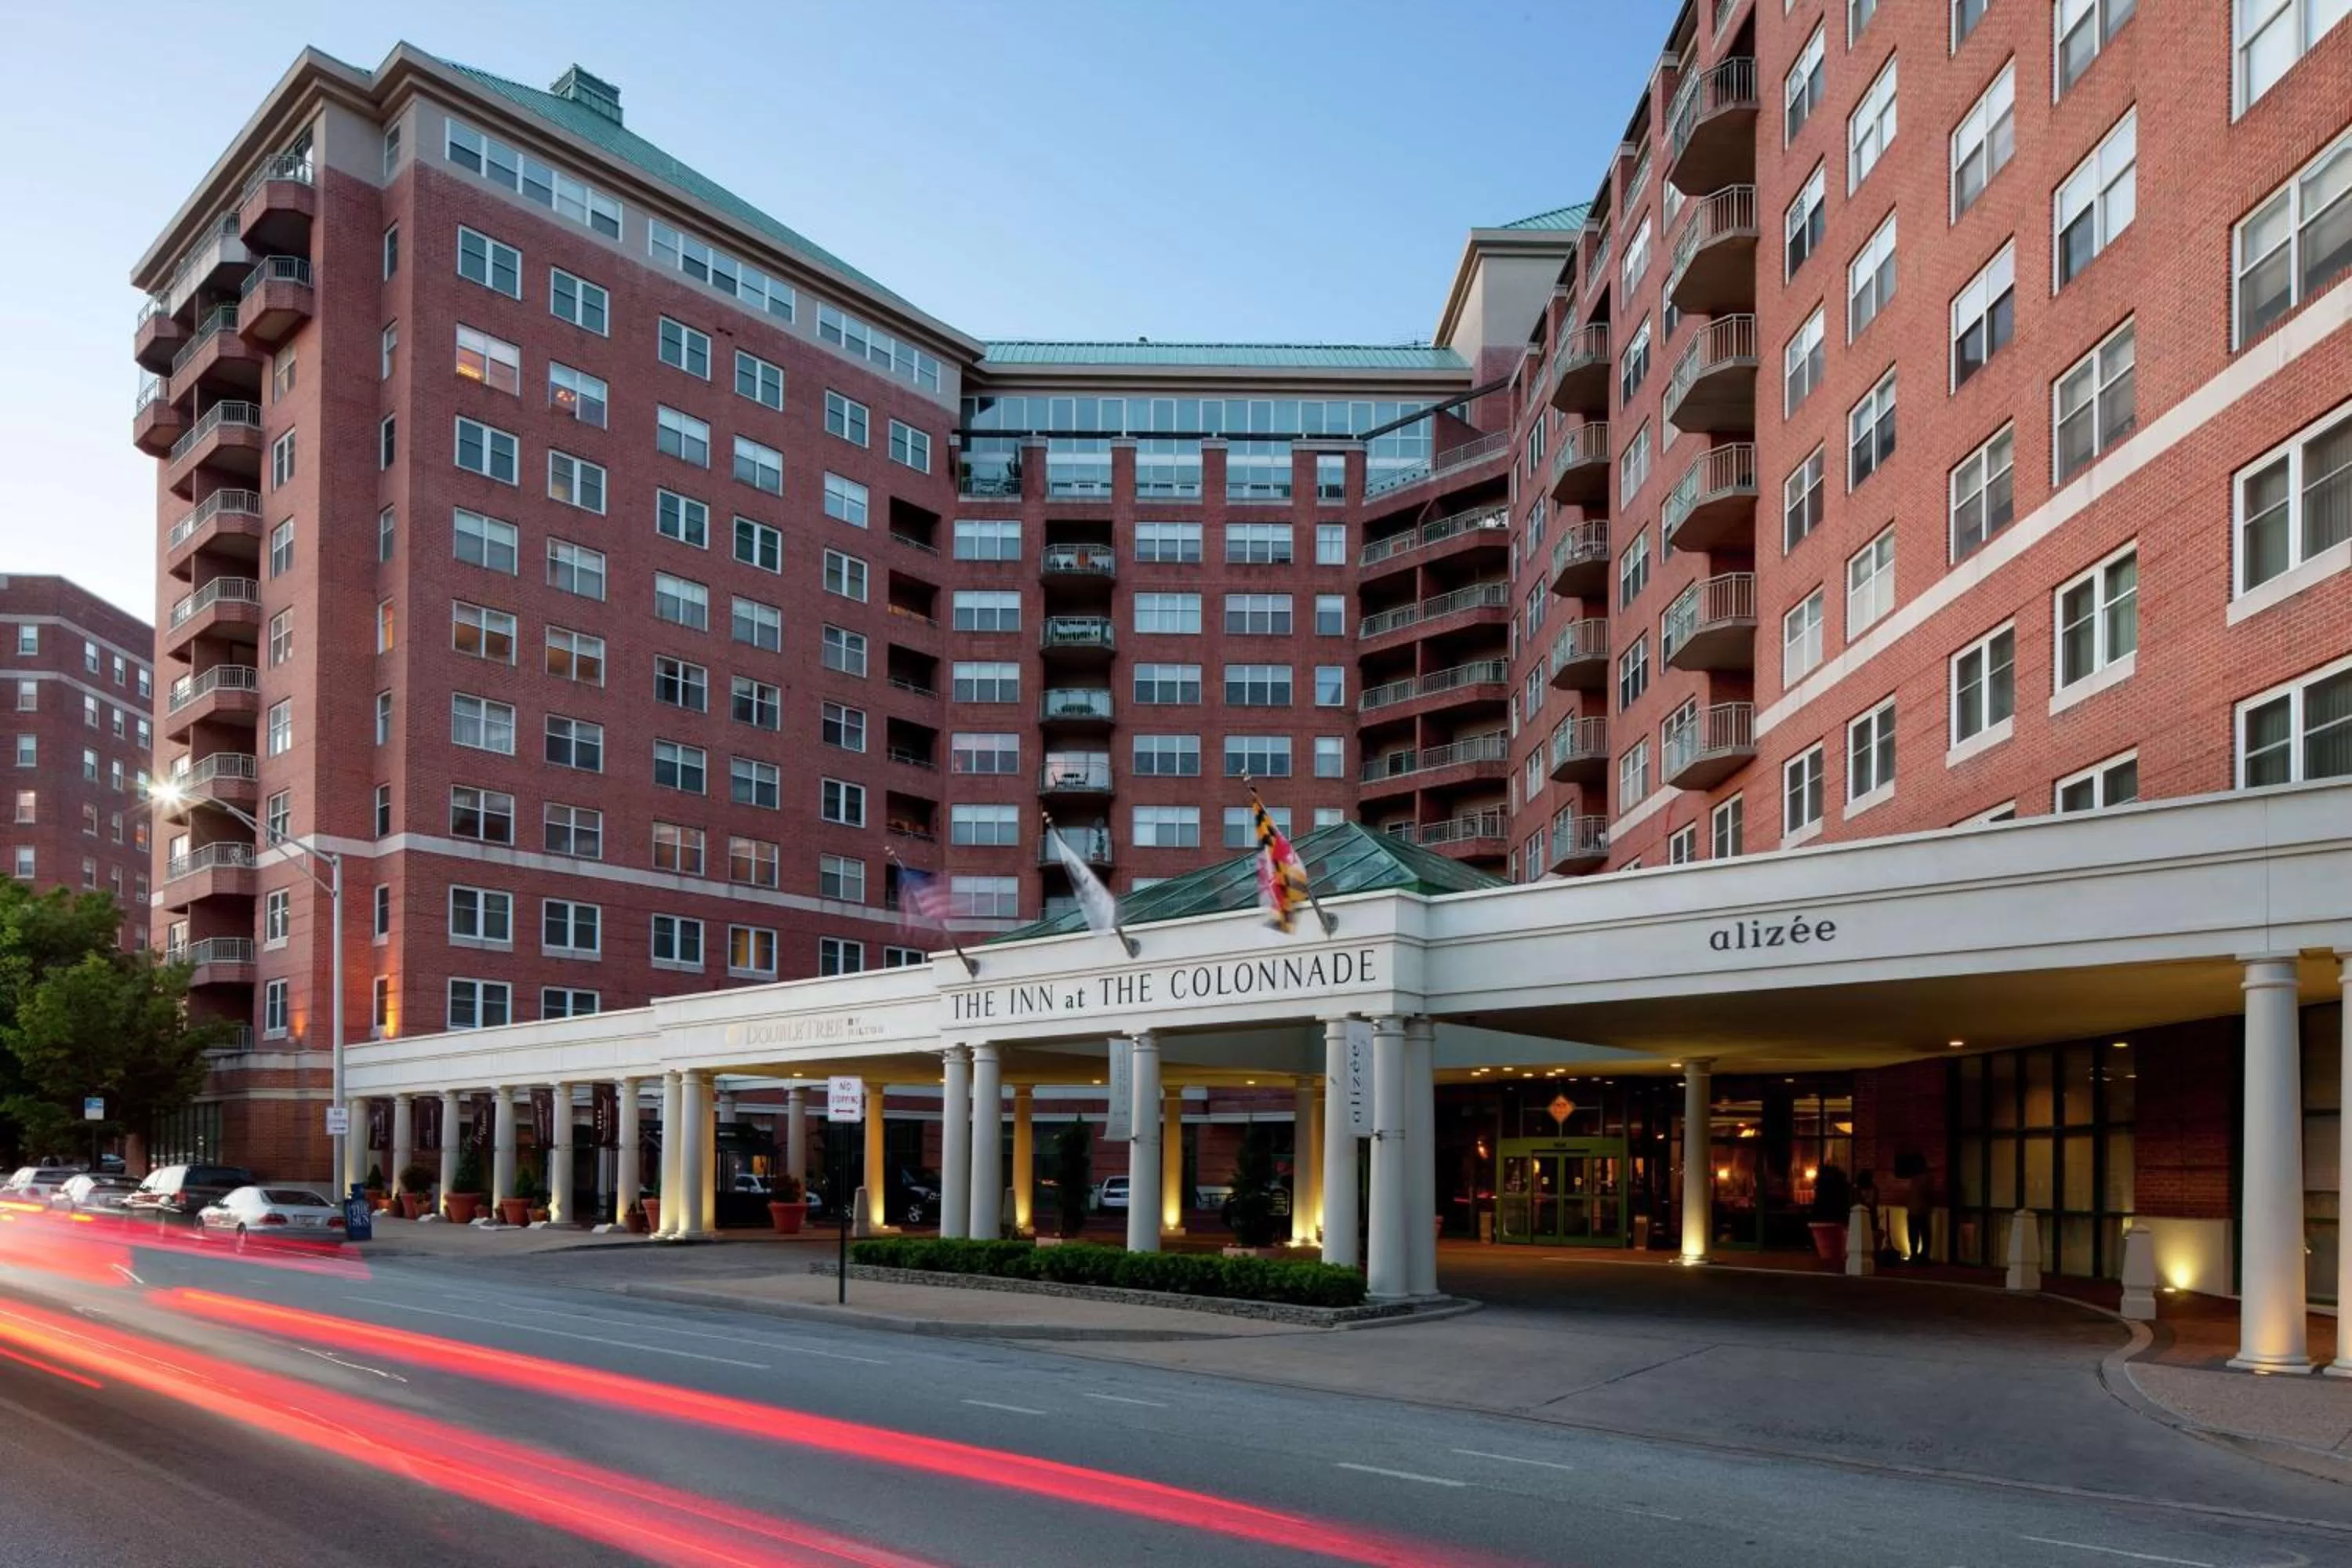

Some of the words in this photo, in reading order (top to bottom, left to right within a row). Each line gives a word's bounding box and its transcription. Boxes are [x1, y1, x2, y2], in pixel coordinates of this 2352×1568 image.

[1710, 915, 1836, 951] alizée
[950, 990, 996, 1019] THE
[1010, 984, 1053, 1014] INN
[1065, 987, 1086, 1009] at
[1098, 973, 1153, 1006] THE
[1171, 949, 1376, 1000] COLONNADE
[839, 1080, 852, 1091] NO
